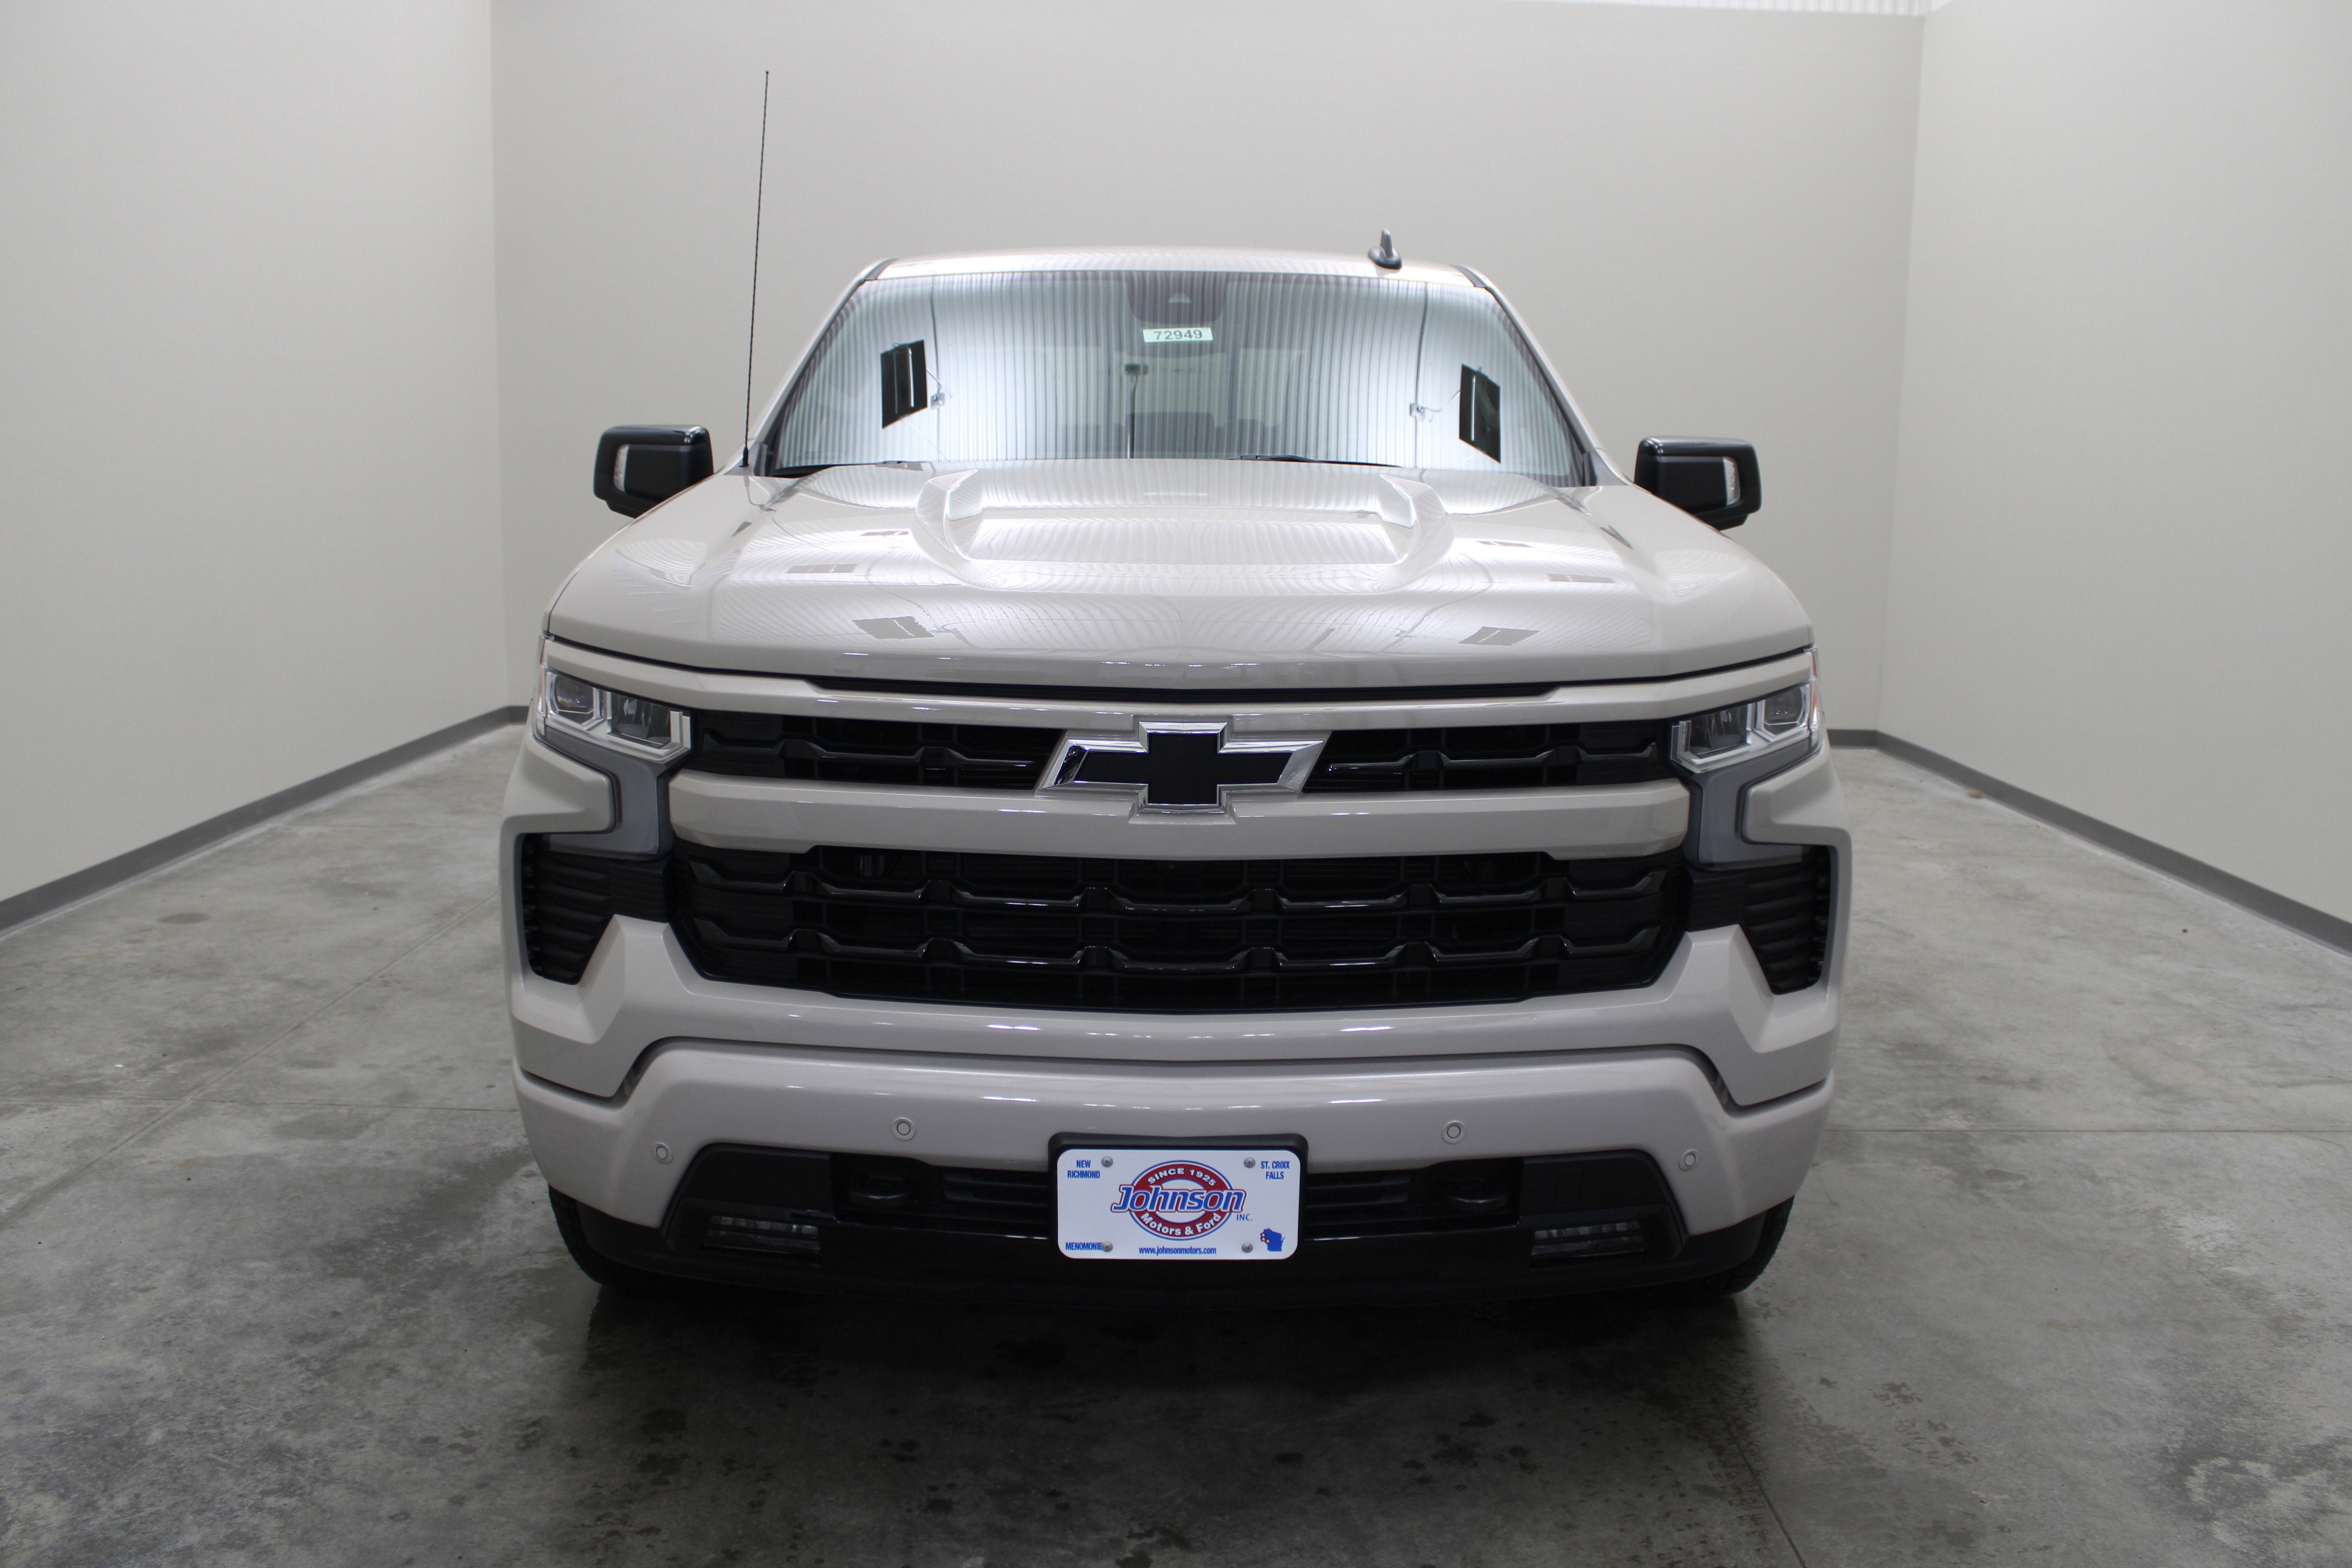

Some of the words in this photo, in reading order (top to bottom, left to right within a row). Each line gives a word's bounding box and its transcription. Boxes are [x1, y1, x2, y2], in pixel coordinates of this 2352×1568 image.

[1154, 329, 1202, 340] 72949
[1076, 1160, 1091, 1168] NEW
[1148, 1168, 1184, 1184] SINCE
[1190, 1169, 1216, 1187] 1925
[1111, 1185, 1245, 1212] Johnson
[1140, 1212, 1182, 1236] Motors
[1185, 1226, 1194, 1235] &
[1195, 1213, 1221, 1233] Ford
[1065, 1242, 1102, 1250] MENOMONIE
[1139, 1246, 1216, 1256] www.johnsonmotors.com
